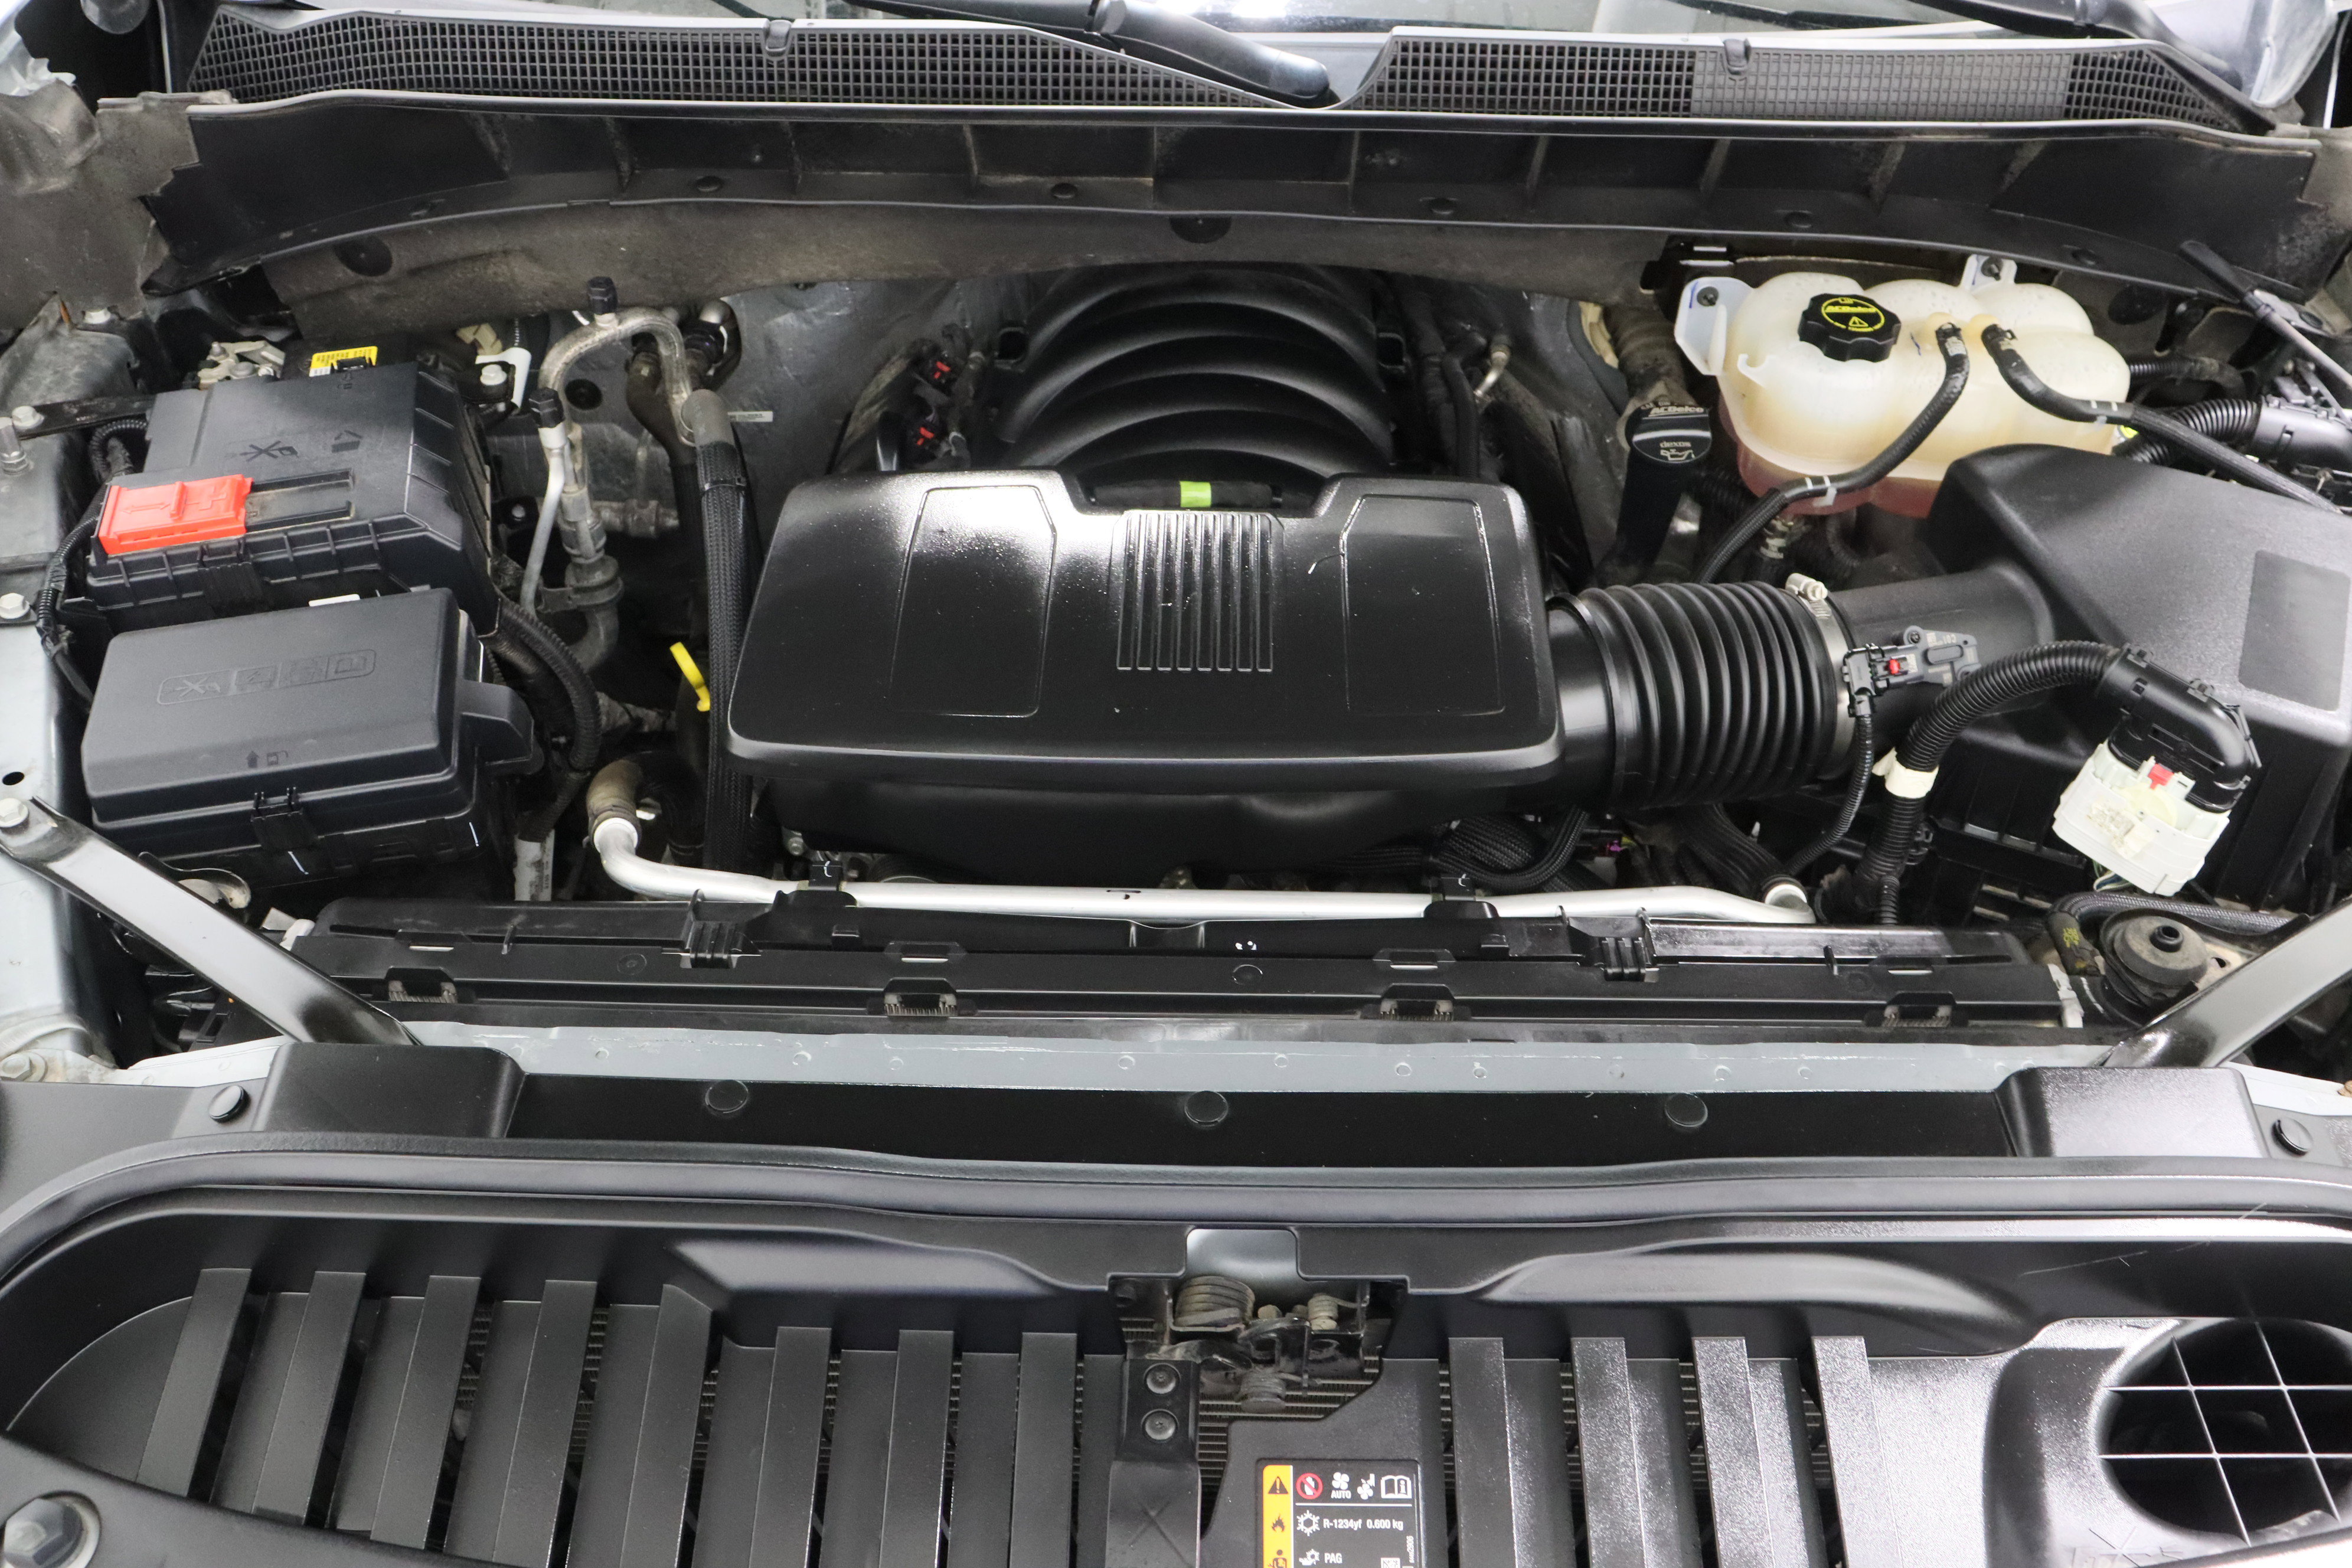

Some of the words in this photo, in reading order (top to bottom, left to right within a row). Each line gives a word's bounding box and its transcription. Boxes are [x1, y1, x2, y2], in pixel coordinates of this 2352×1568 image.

[1650, 405, 1704, 415] ACDelco
[1331, 1490, 1351, 1499] AUTO
[1323, 1519, 1362, 1531] R-1234yf
[1366, 1519, 1391, 1528] 0.600
[1392, 1519, 1404, 1531] kg
[1324, 1553, 1342, 1564] PAG
